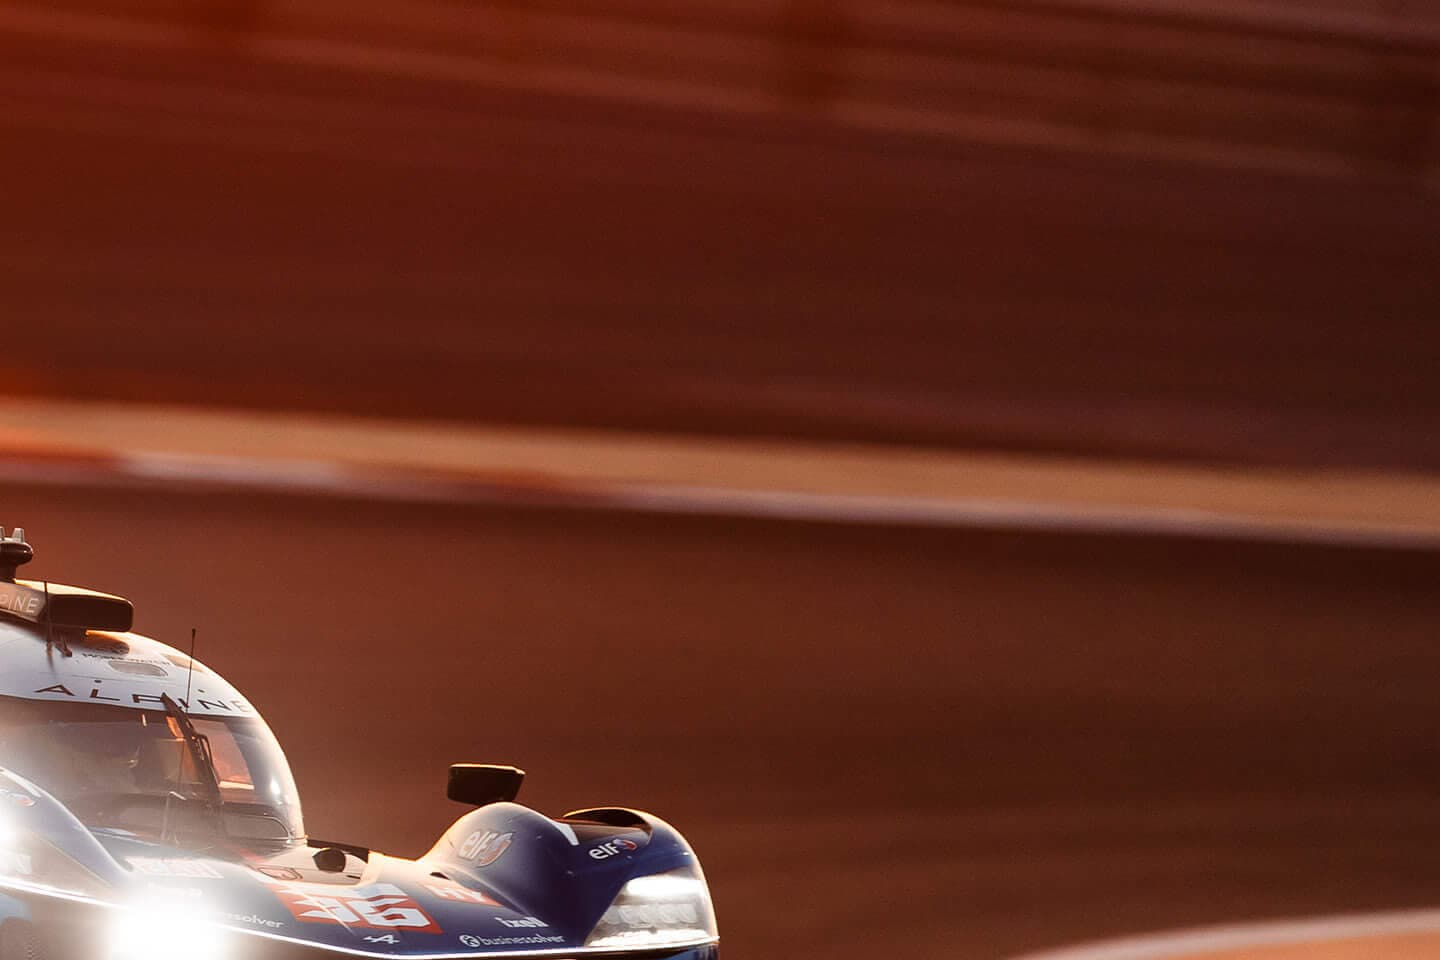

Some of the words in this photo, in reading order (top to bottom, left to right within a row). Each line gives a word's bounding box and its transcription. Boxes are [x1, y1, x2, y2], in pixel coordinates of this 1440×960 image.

[34, 684, 253, 713] ALPINE
[461, 831, 498, 860] elf
[589, 840, 621, 860] elf
[278, 884, 431, 927] 36
[476, 933, 566, 946] businessolver
